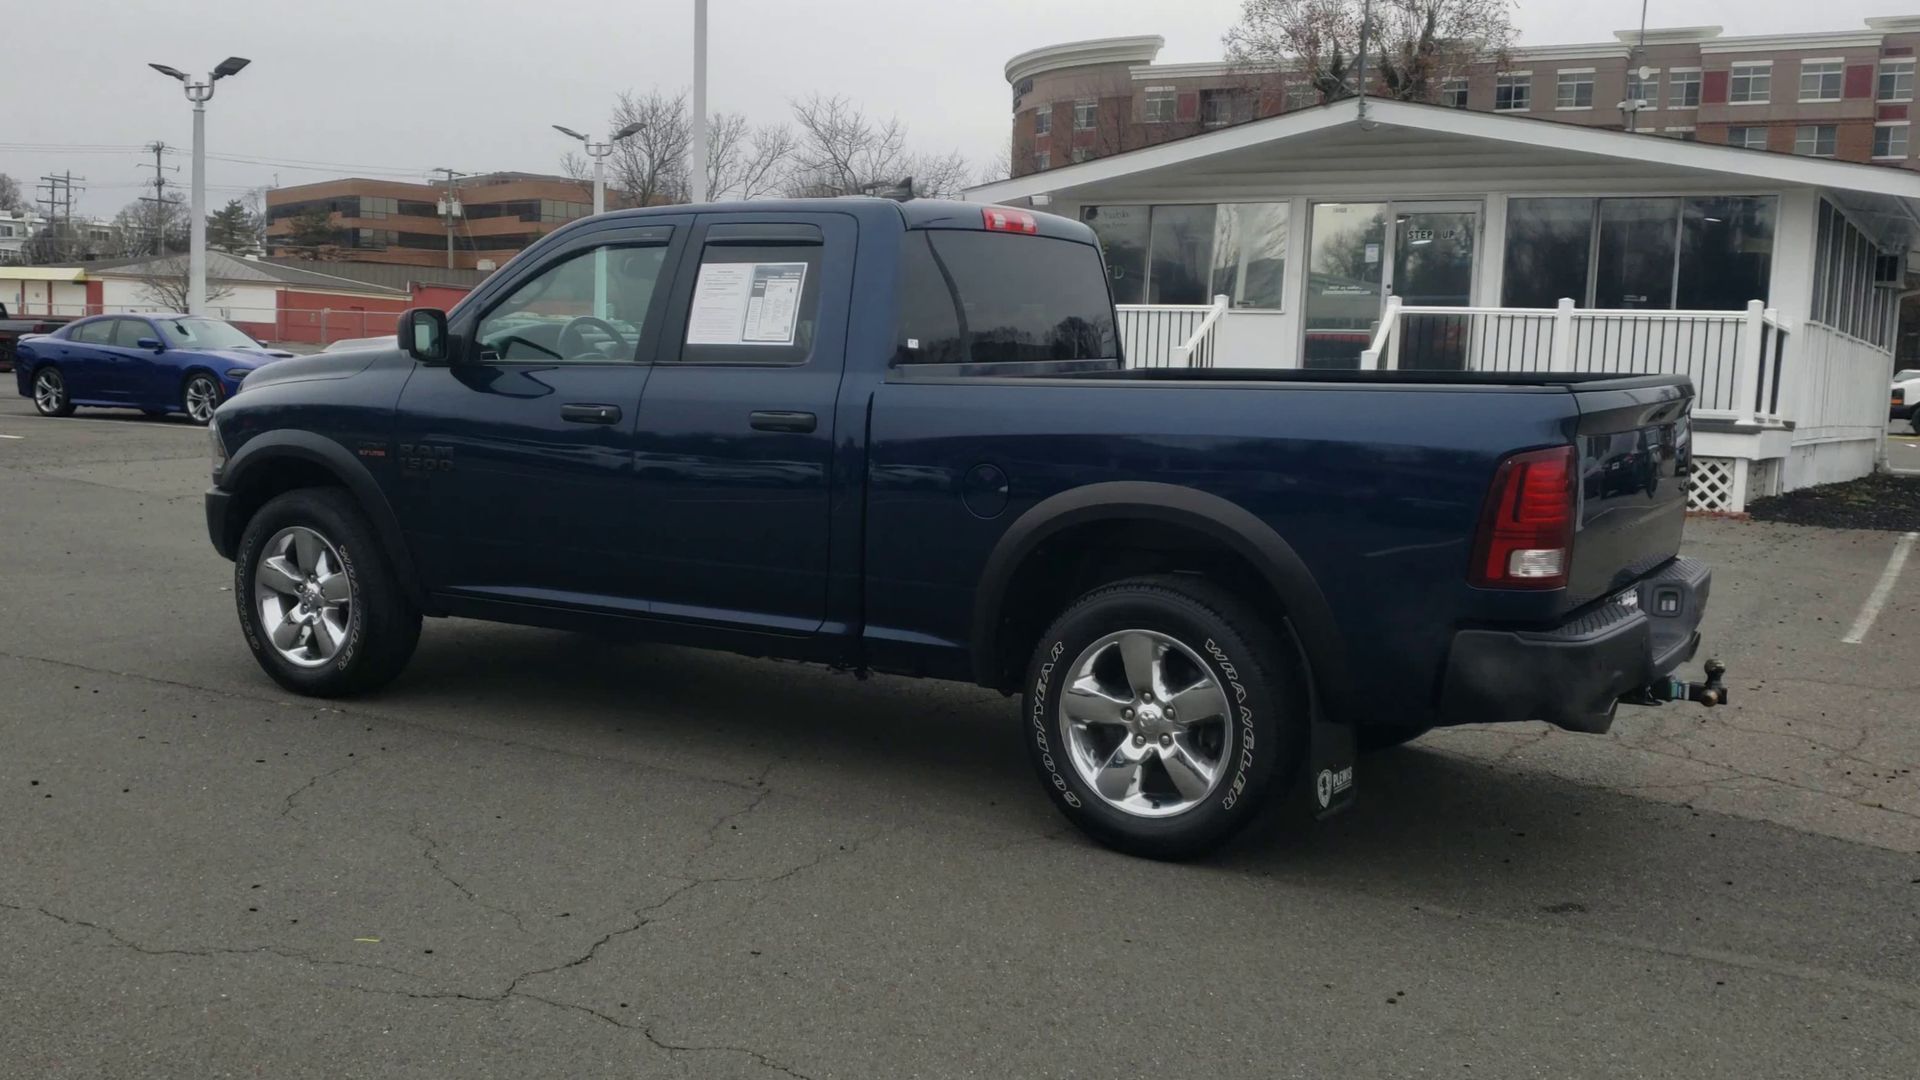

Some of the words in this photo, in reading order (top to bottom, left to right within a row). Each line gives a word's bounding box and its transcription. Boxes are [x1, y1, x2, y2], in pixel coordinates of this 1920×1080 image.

[1408, 230, 1433, 239] STEP
[1441, 231, 1455, 239] UP
[399, 444, 454, 457] RAM
[400, 457, 454, 471] 1500
[1031, 641, 1082, 808] GOODYEAR
[1204, 638, 1256, 810] WRANGLER
